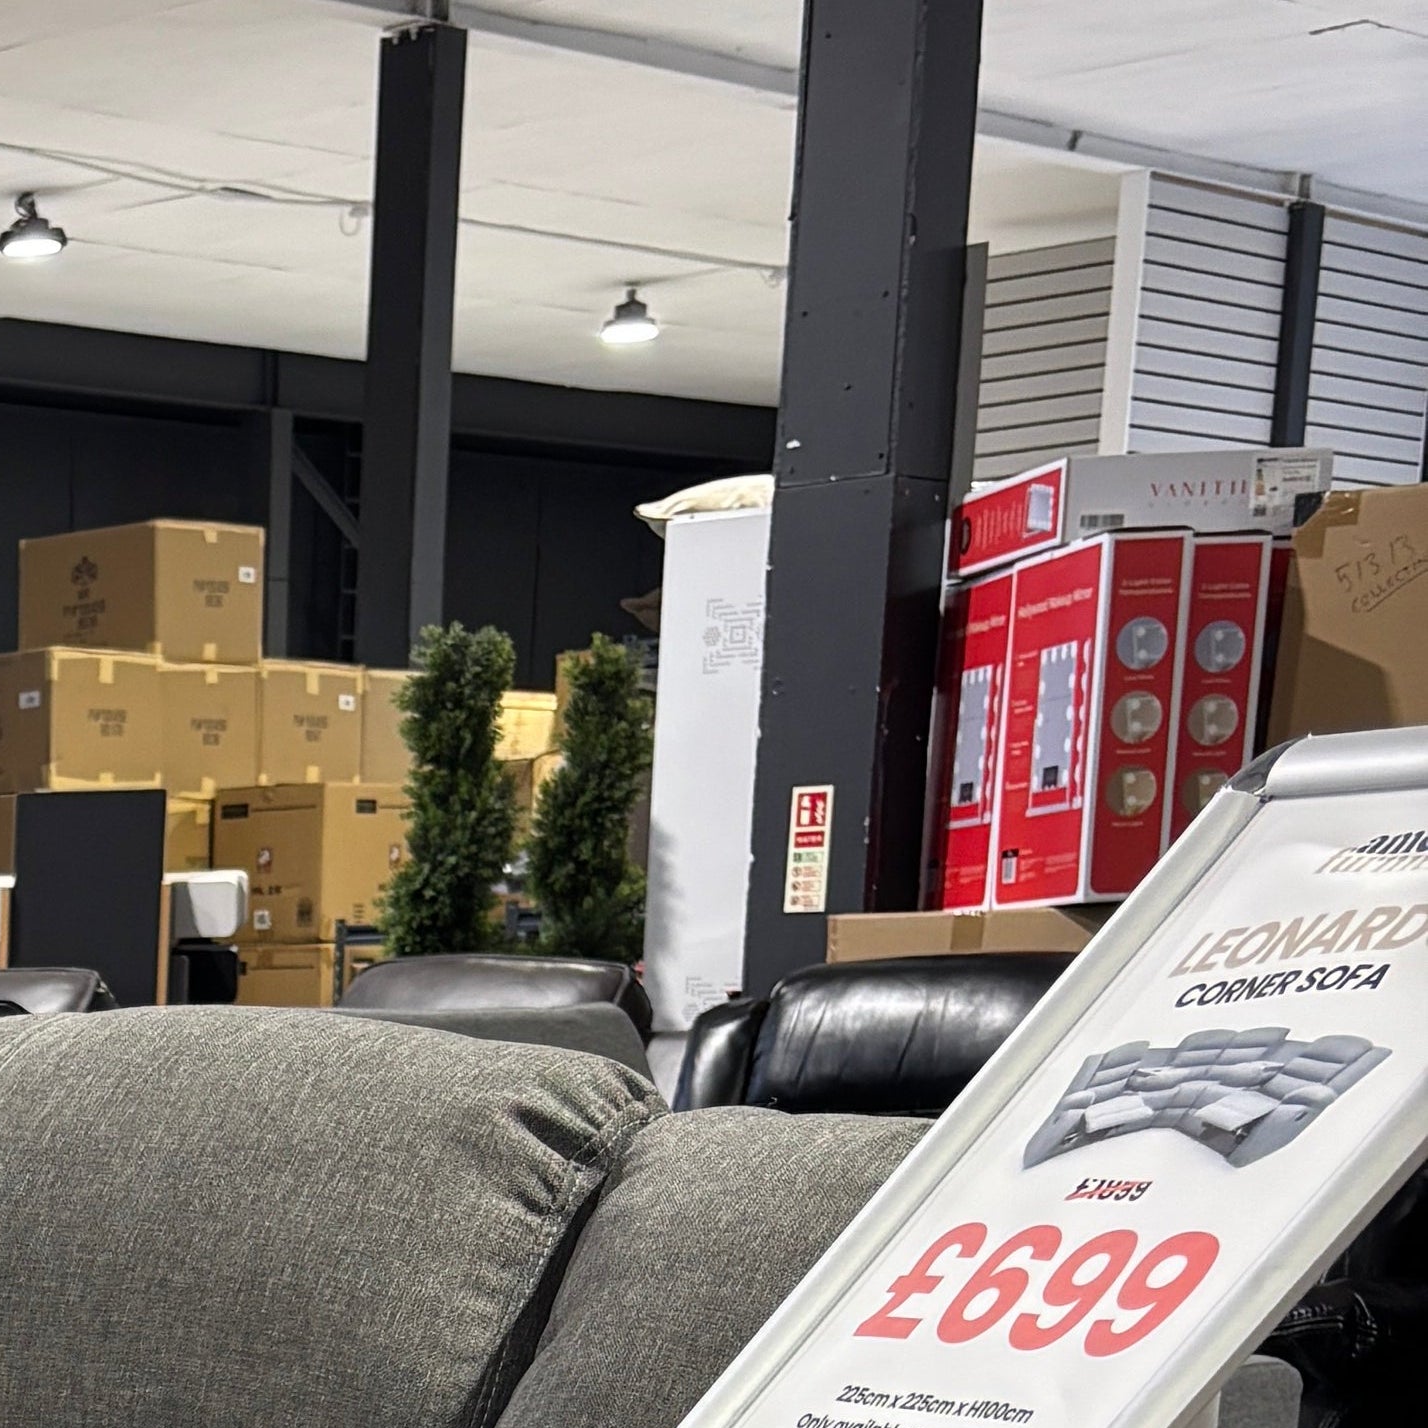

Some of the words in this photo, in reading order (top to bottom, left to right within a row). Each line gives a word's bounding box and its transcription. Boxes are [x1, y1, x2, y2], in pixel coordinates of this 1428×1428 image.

[1167, 903, 1428, 978] LEONARD
[1174, 969, 1303, 1008] CORNER
[1293, 963, 1392, 993] SOFA
[852, 1221, 1221, 1358] £699
[835, 1384, 890, 1409] 225cm
[887, 1395, 901, 1409] x
[899, 1392, 956, 1416] 225cm
[954, 1401, 970, 1417] x
[965, 1399, 1035, 1425] H100cm
